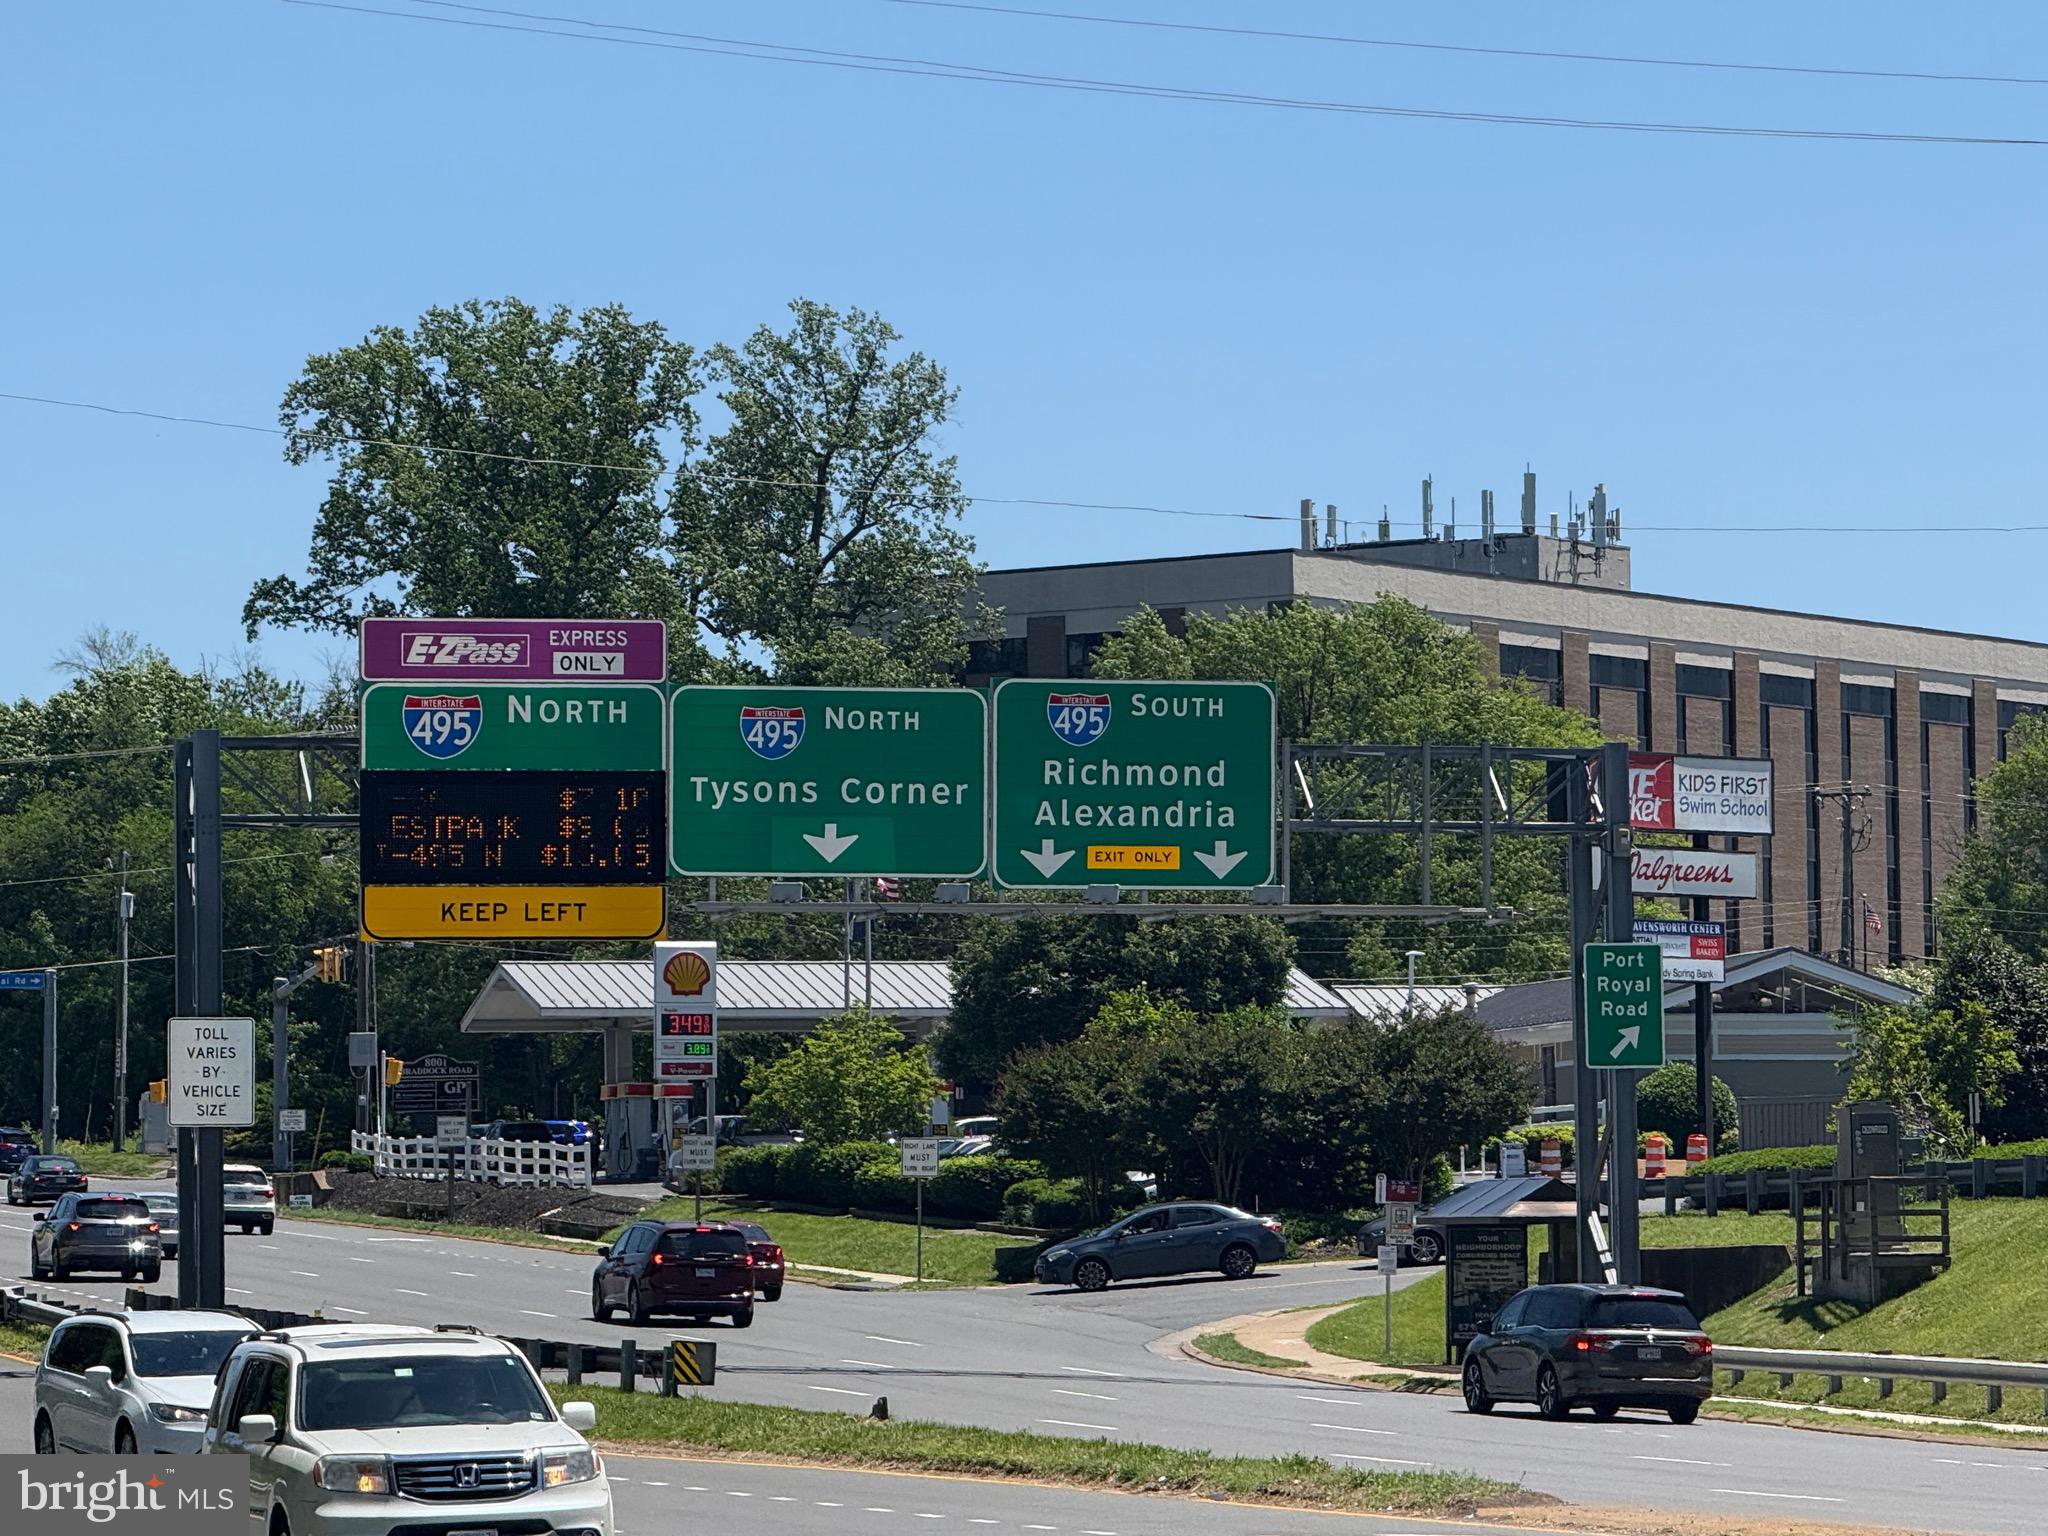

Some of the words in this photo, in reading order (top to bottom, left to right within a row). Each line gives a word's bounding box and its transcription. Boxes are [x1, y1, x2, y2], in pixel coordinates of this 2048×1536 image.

[549, 630, 628, 647] EXPRESS
[560, 655, 617, 672] ONLY
[420, 699, 465, 708] INTERSTATE
[1061, 696, 1098, 705] INTERSTATE
[1131, 693, 1224, 718] SOUTH
[508, 694, 627, 724] NORTH
[754, 709, 791, 718] INTERSTATE
[825, 706, 920, 731] NORTH
[1054, 706, 1105, 736] 495
[411, 711, 473, 746] 495
[746, 720, 798, 750] 495
[1044, 757, 1225, 787] Richmond
[1678, 773, 1716, 793] KIDS
[1720, 776, 1768, 795] FIRST
[690, 776, 818, 810] Tysons
[841, 777, 968, 805] Corner
[1034, 799, 1236, 828] Alexandria
[1630, 794, 1662, 823] ket
[1679, 796, 1716, 814] Swim
[1720, 799, 1768, 817] School
[1095, 852, 1125, 862] EXIT
[1134, 852, 1172, 862] ONLY
[441, 903, 508, 922] KEEP
[525, 903, 588, 922] LEFT
[1633, 921, 1688, 934] AVENSWORTH
[1689, 923, 1721, 934] CENTER
[1698, 938, 1718, 947] SWISS
[1603, 952, 1644, 968] Port
[1696, 948, 1719, 956] BAKERY
[15, 977, 26, 985] Rd
[1697, 970, 1714, 979] Bank
[1597, 976, 1651, 996] Royal
[1601, 1001, 1648, 1017] Road
[194, 1027, 229, 1041] TOLL
[186, 1046, 237, 1059] VARIES
[424, 1058, 448, 1067] 8001
[202, 1066, 220, 1078] BY
[182, 1085, 241, 1098] VEHICLE
[196, 1104, 227, 1117] SIZE
[910, 1153, 930, 1162] MUST
